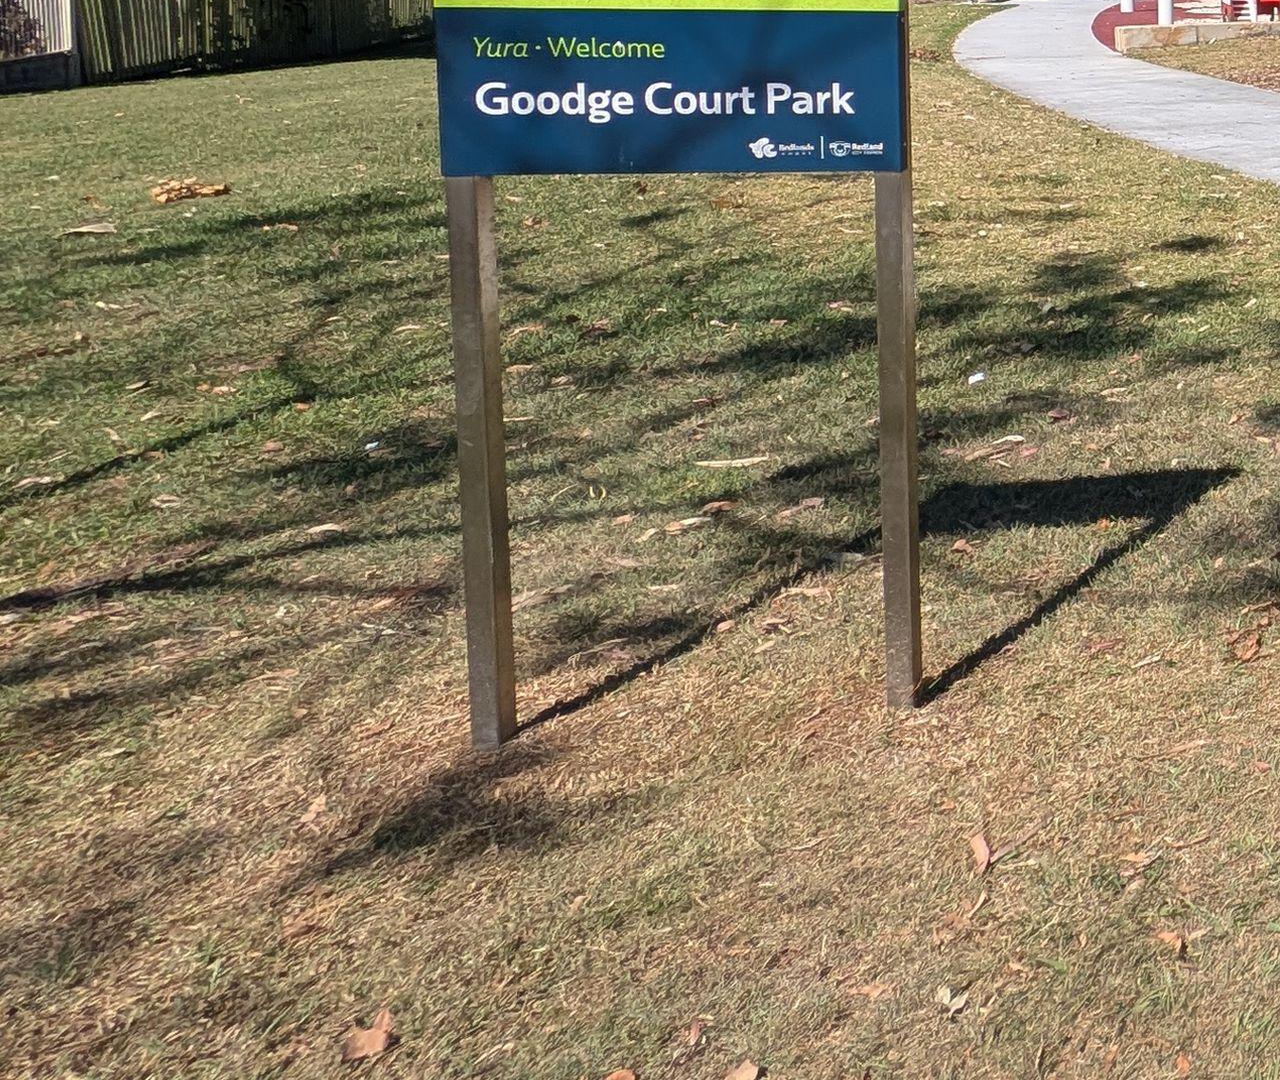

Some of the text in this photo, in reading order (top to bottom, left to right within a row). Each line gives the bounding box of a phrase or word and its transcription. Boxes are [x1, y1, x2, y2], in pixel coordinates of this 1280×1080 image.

[473, 36, 529, 58] Yura
[546, 36, 666, 59] Welcome
[475, 81, 856, 124] Goodge Court Park
